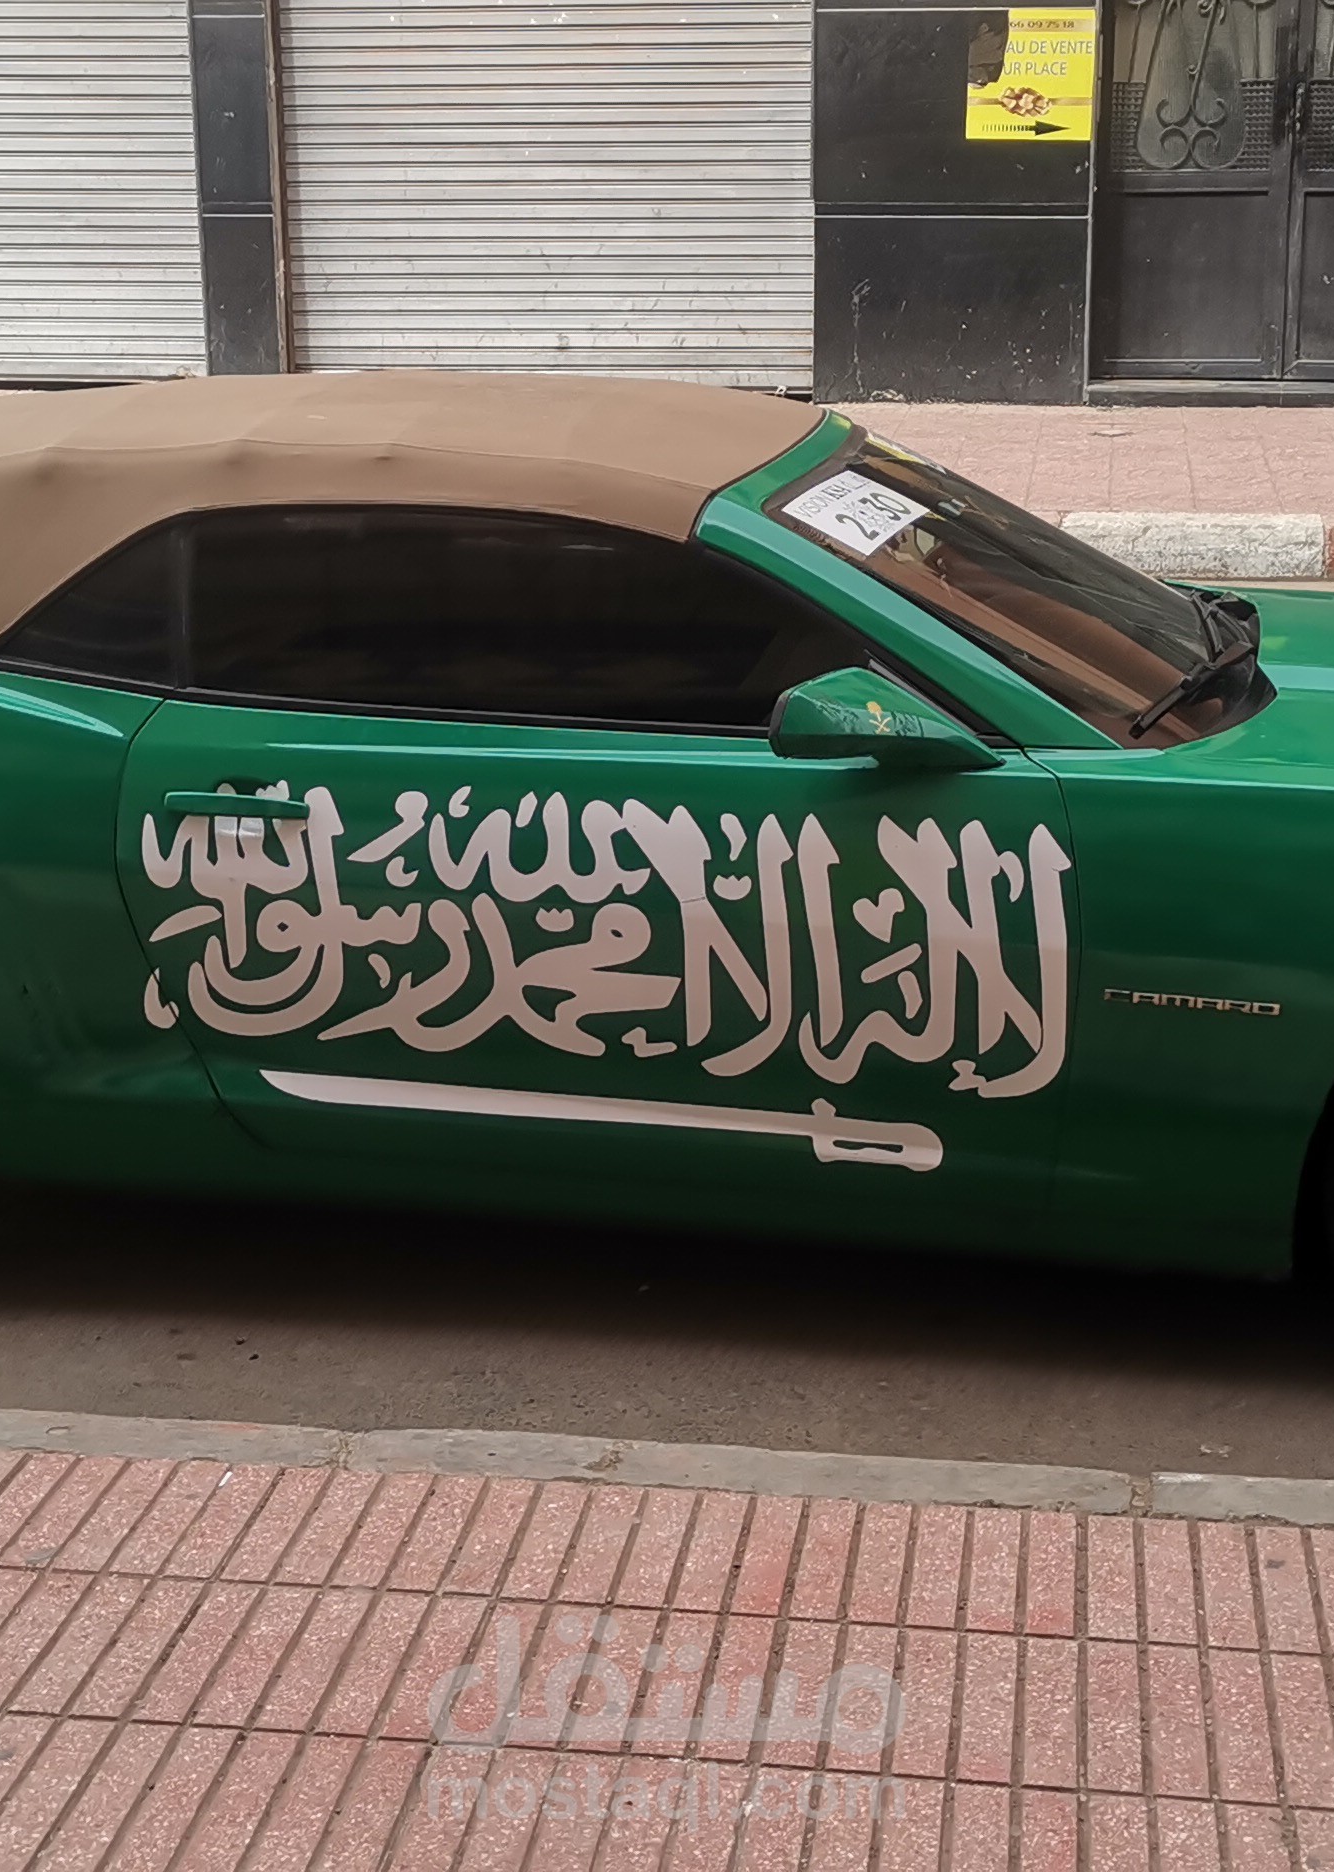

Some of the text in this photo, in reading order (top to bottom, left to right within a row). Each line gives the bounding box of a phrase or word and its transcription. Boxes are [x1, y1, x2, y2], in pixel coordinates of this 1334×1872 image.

[1006, 40, 1093, 55] AU DE VENTE
[1004, 61, 1068, 76] UR PLACE
[1104, 988, 1281, 1017] CAMARO
